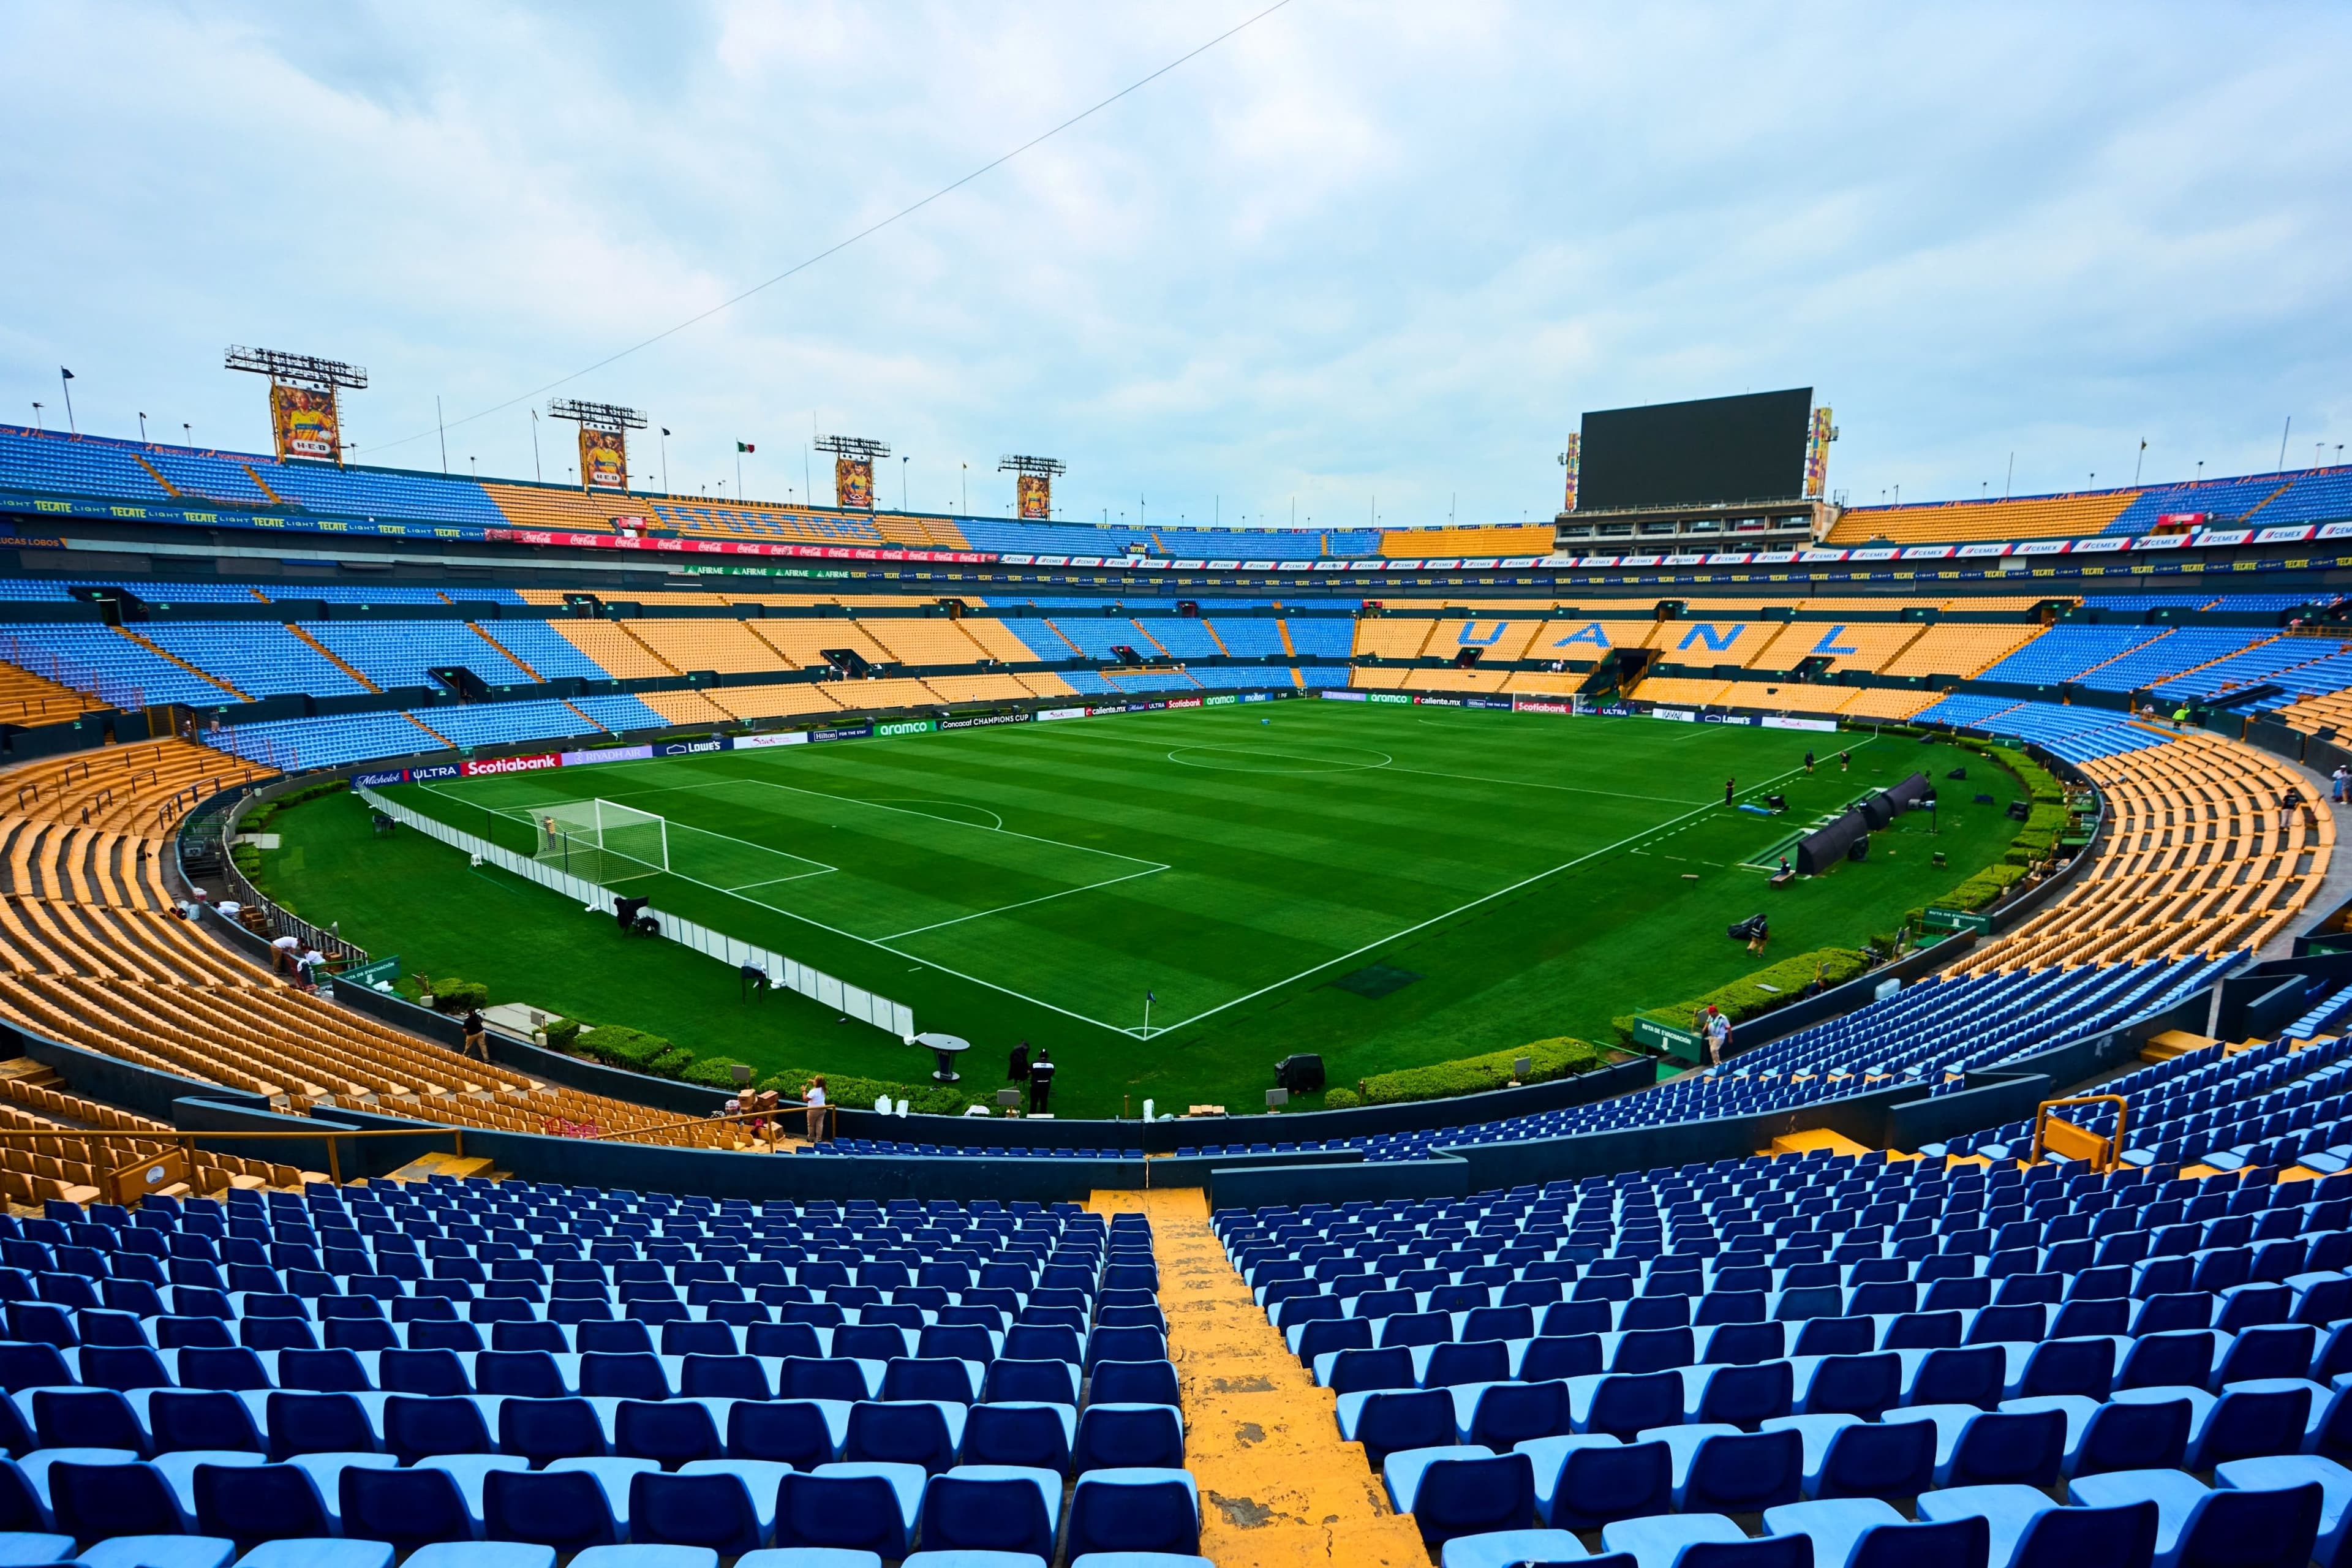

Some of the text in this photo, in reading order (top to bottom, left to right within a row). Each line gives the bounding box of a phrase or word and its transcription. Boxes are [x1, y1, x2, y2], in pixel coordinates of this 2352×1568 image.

[34, 500, 72, 513] TECATE
[110, 507, 146, 518] TECATE
[183, 511, 217, 523] TECATE
[252, 517, 285, 528] TECATE
[317, 521, 347, 532] TECATE
[377, 524, 405, 535] TECATE
[434, 528, 461, 538] TECATE
[2180, 564, 2205, 572] TECATE
[2232, 562, 2258, 571] TECATE
[2284, 559, 2310, 568] TECATE
[697, 566, 724, 575] AFIRME
[1207, 695, 1235, 705] aramco
[1245, 692, 1265, 702] molten
[1371, 693, 1408, 703] aramco
[1420, 697, 1461, 706] caliente.mx
[1169, 698, 1200, 709] Scotiabank
[1518, 702, 1567, 713] Scotiabank
[1092, 706, 1126, 715] caliente.mx
[943, 719, 972, 728] Concacaf
[973, 715, 1014, 726] CHAMPIONS
[880, 722, 927, 735] aramco
[816, 731, 835, 740] Hilton
[586, 748, 641, 762] RIYADH AIR
[468, 755, 556, 776] Scotiabank
[355, 766, 456, 786] Michelob ULTRA
[1952, 913, 1986, 922] EVACUACIÓN
[1642, 1023, 1654, 1032] RUTA
